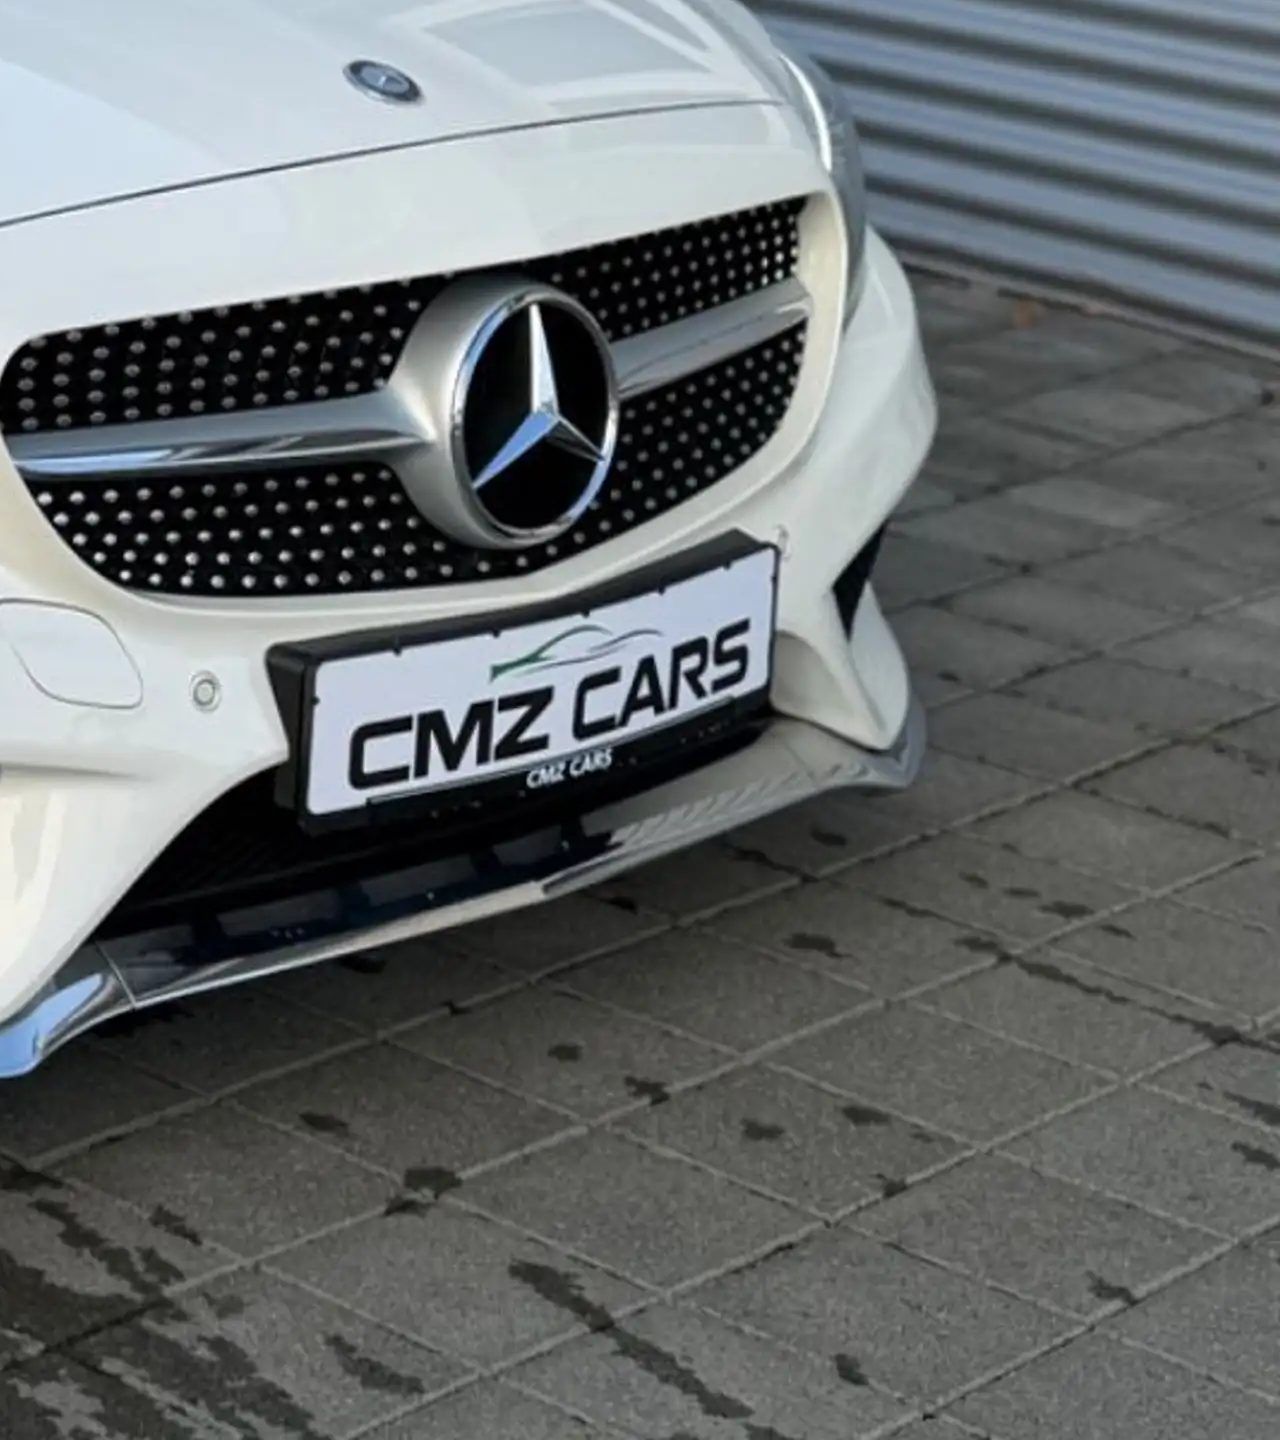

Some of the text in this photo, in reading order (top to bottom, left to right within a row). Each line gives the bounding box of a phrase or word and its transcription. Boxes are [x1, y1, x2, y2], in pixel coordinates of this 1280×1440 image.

[348, 618, 751, 790] CMZ CARS
[526, 747, 614, 789] CMZ CARS
